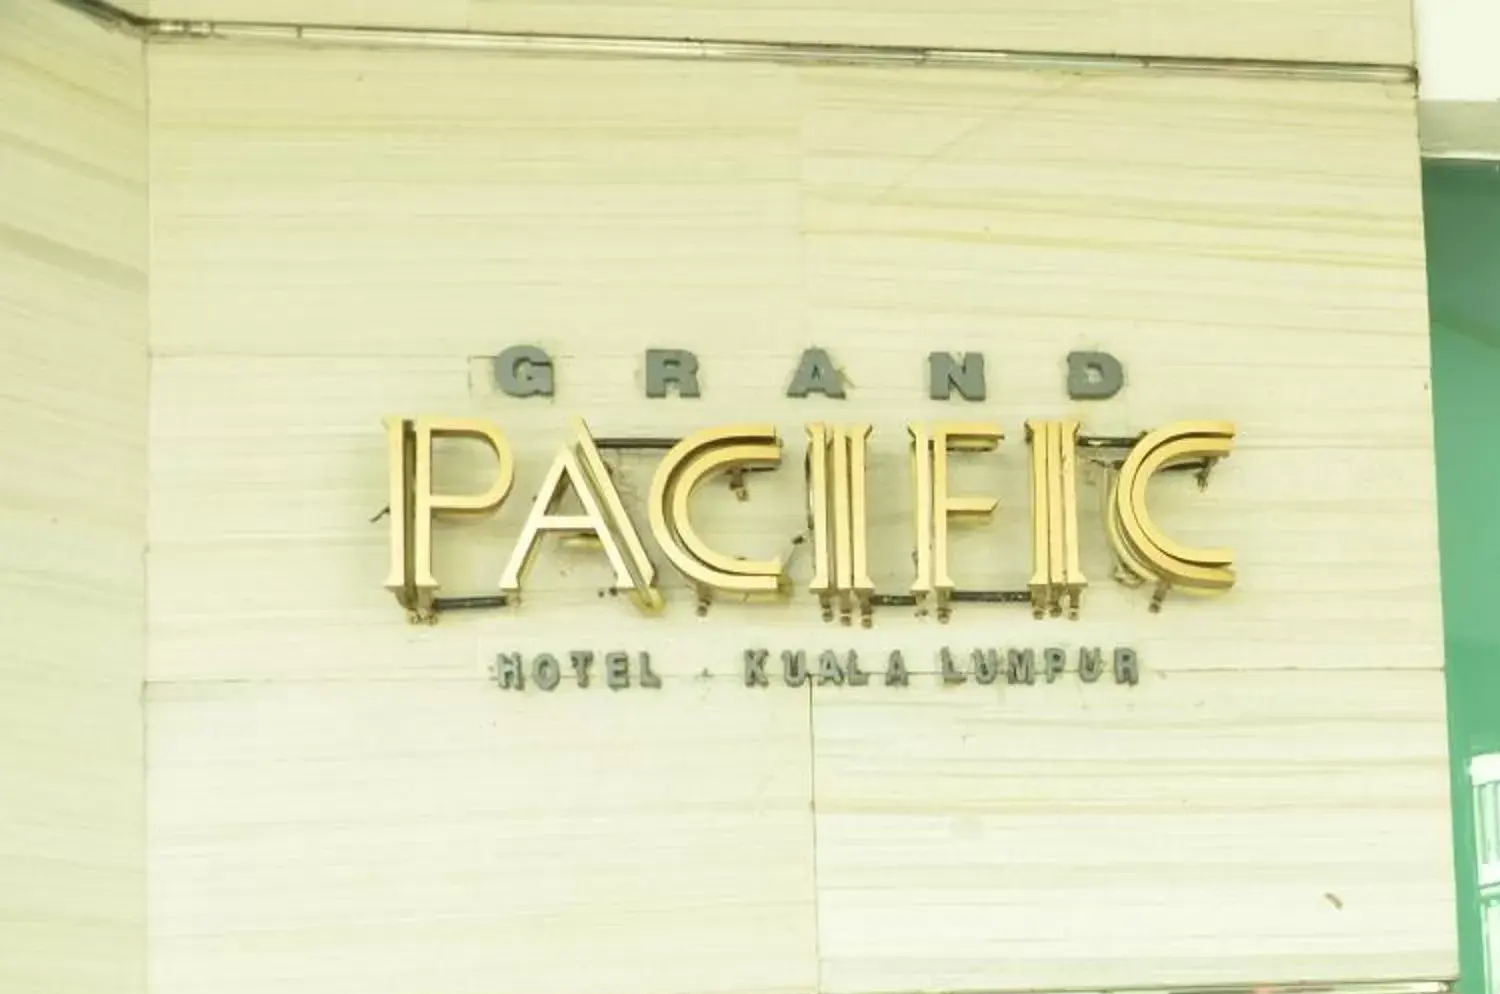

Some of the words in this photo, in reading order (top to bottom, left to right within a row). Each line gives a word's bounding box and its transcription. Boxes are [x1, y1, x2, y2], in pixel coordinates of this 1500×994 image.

[494, 345, 1124, 400] GRAND
[384, 416, 1237, 604] PACIFIC
[496, 649, 663, 691] HOTEL
[743, 648, 909, 687] KUALA
[940, 646, 1139, 687] LUMPUR
